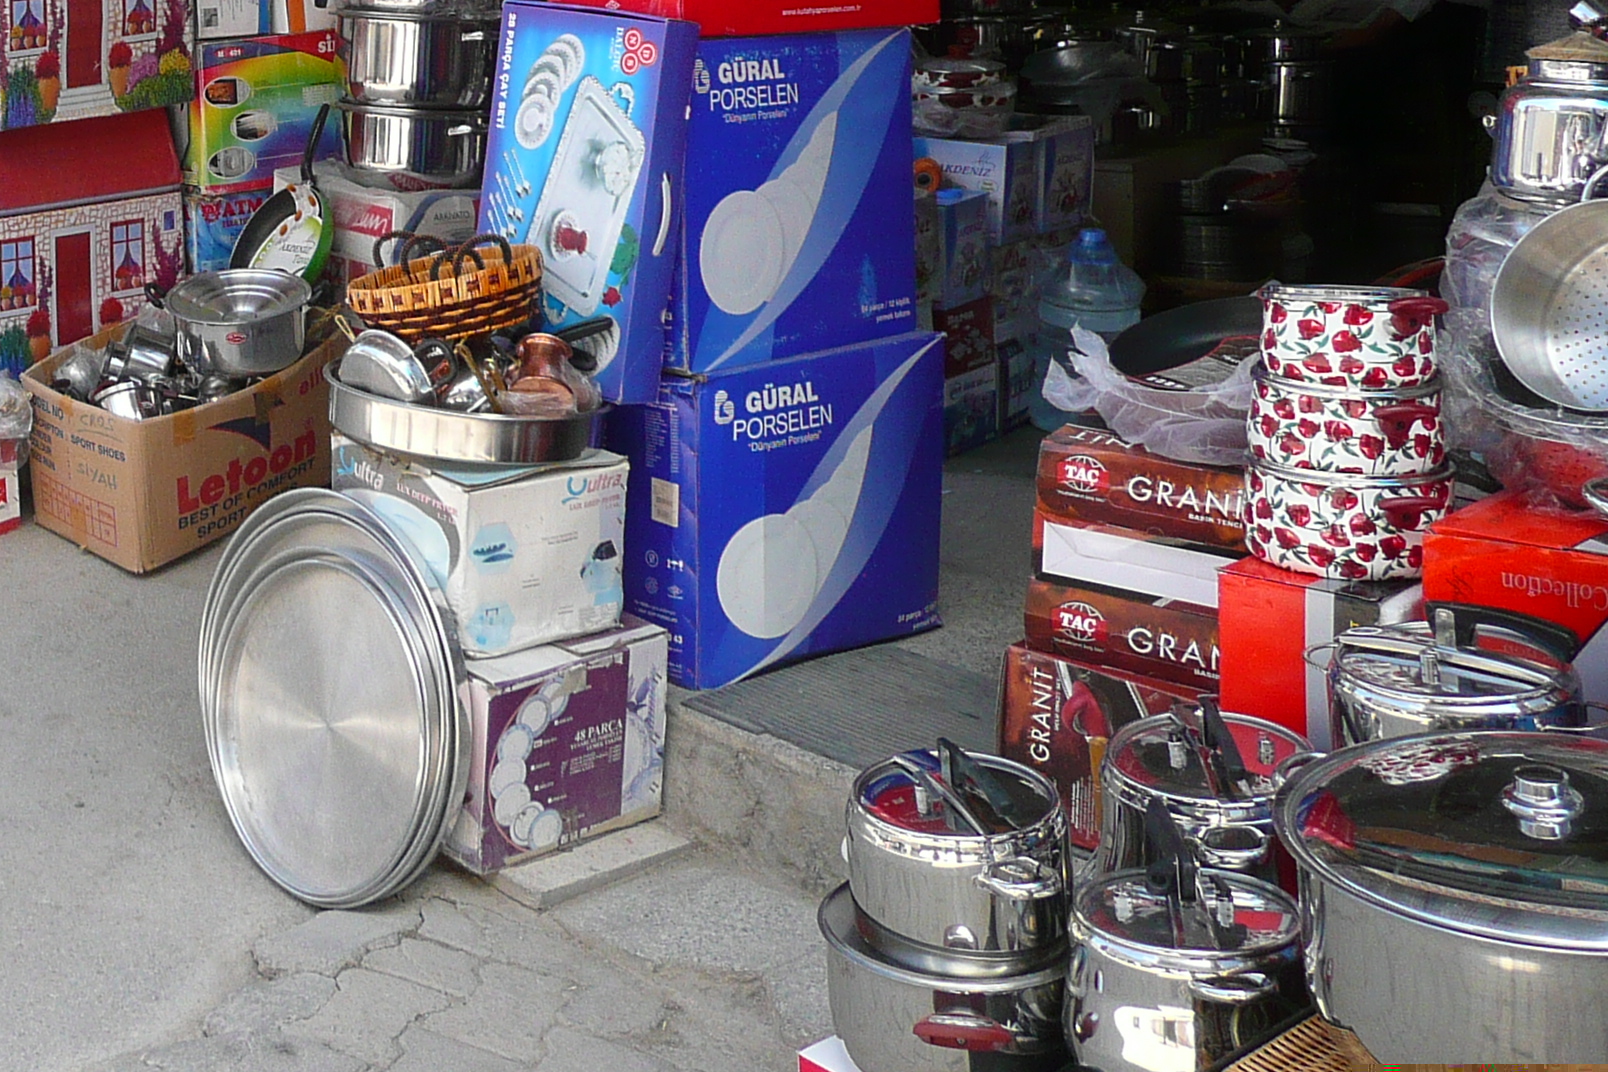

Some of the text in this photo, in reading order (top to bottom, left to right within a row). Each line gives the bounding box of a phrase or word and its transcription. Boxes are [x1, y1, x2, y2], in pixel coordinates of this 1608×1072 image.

[501, 30, 515, 70] PARÇA
[718, 57, 785, 84] GÜRAL
[499, 73, 510, 99] ÇAY
[710, 82, 799, 111] PORSELEN
[746, 381, 818, 413] GÜRAL
[733, 403, 832, 441] PORSELEN
[71, 434, 126, 462] SPORT SHOES
[177, 430, 316, 515] Letoon
[354, 461, 384, 491] ultra
[587, 473, 622, 493] ultra
[1065, 464, 1100, 487] TAÇ
[178, 503, 221, 530] BEST
[223, 493, 245, 509] OF
[247, 456, 316, 500] COMFORT
[1128, 475, 1243, 519] GRANİ
[197, 506, 247, 539] SPORT
[1059, 612, 1096, 636] TAÇ
[574, 731, 586, 741] 48
